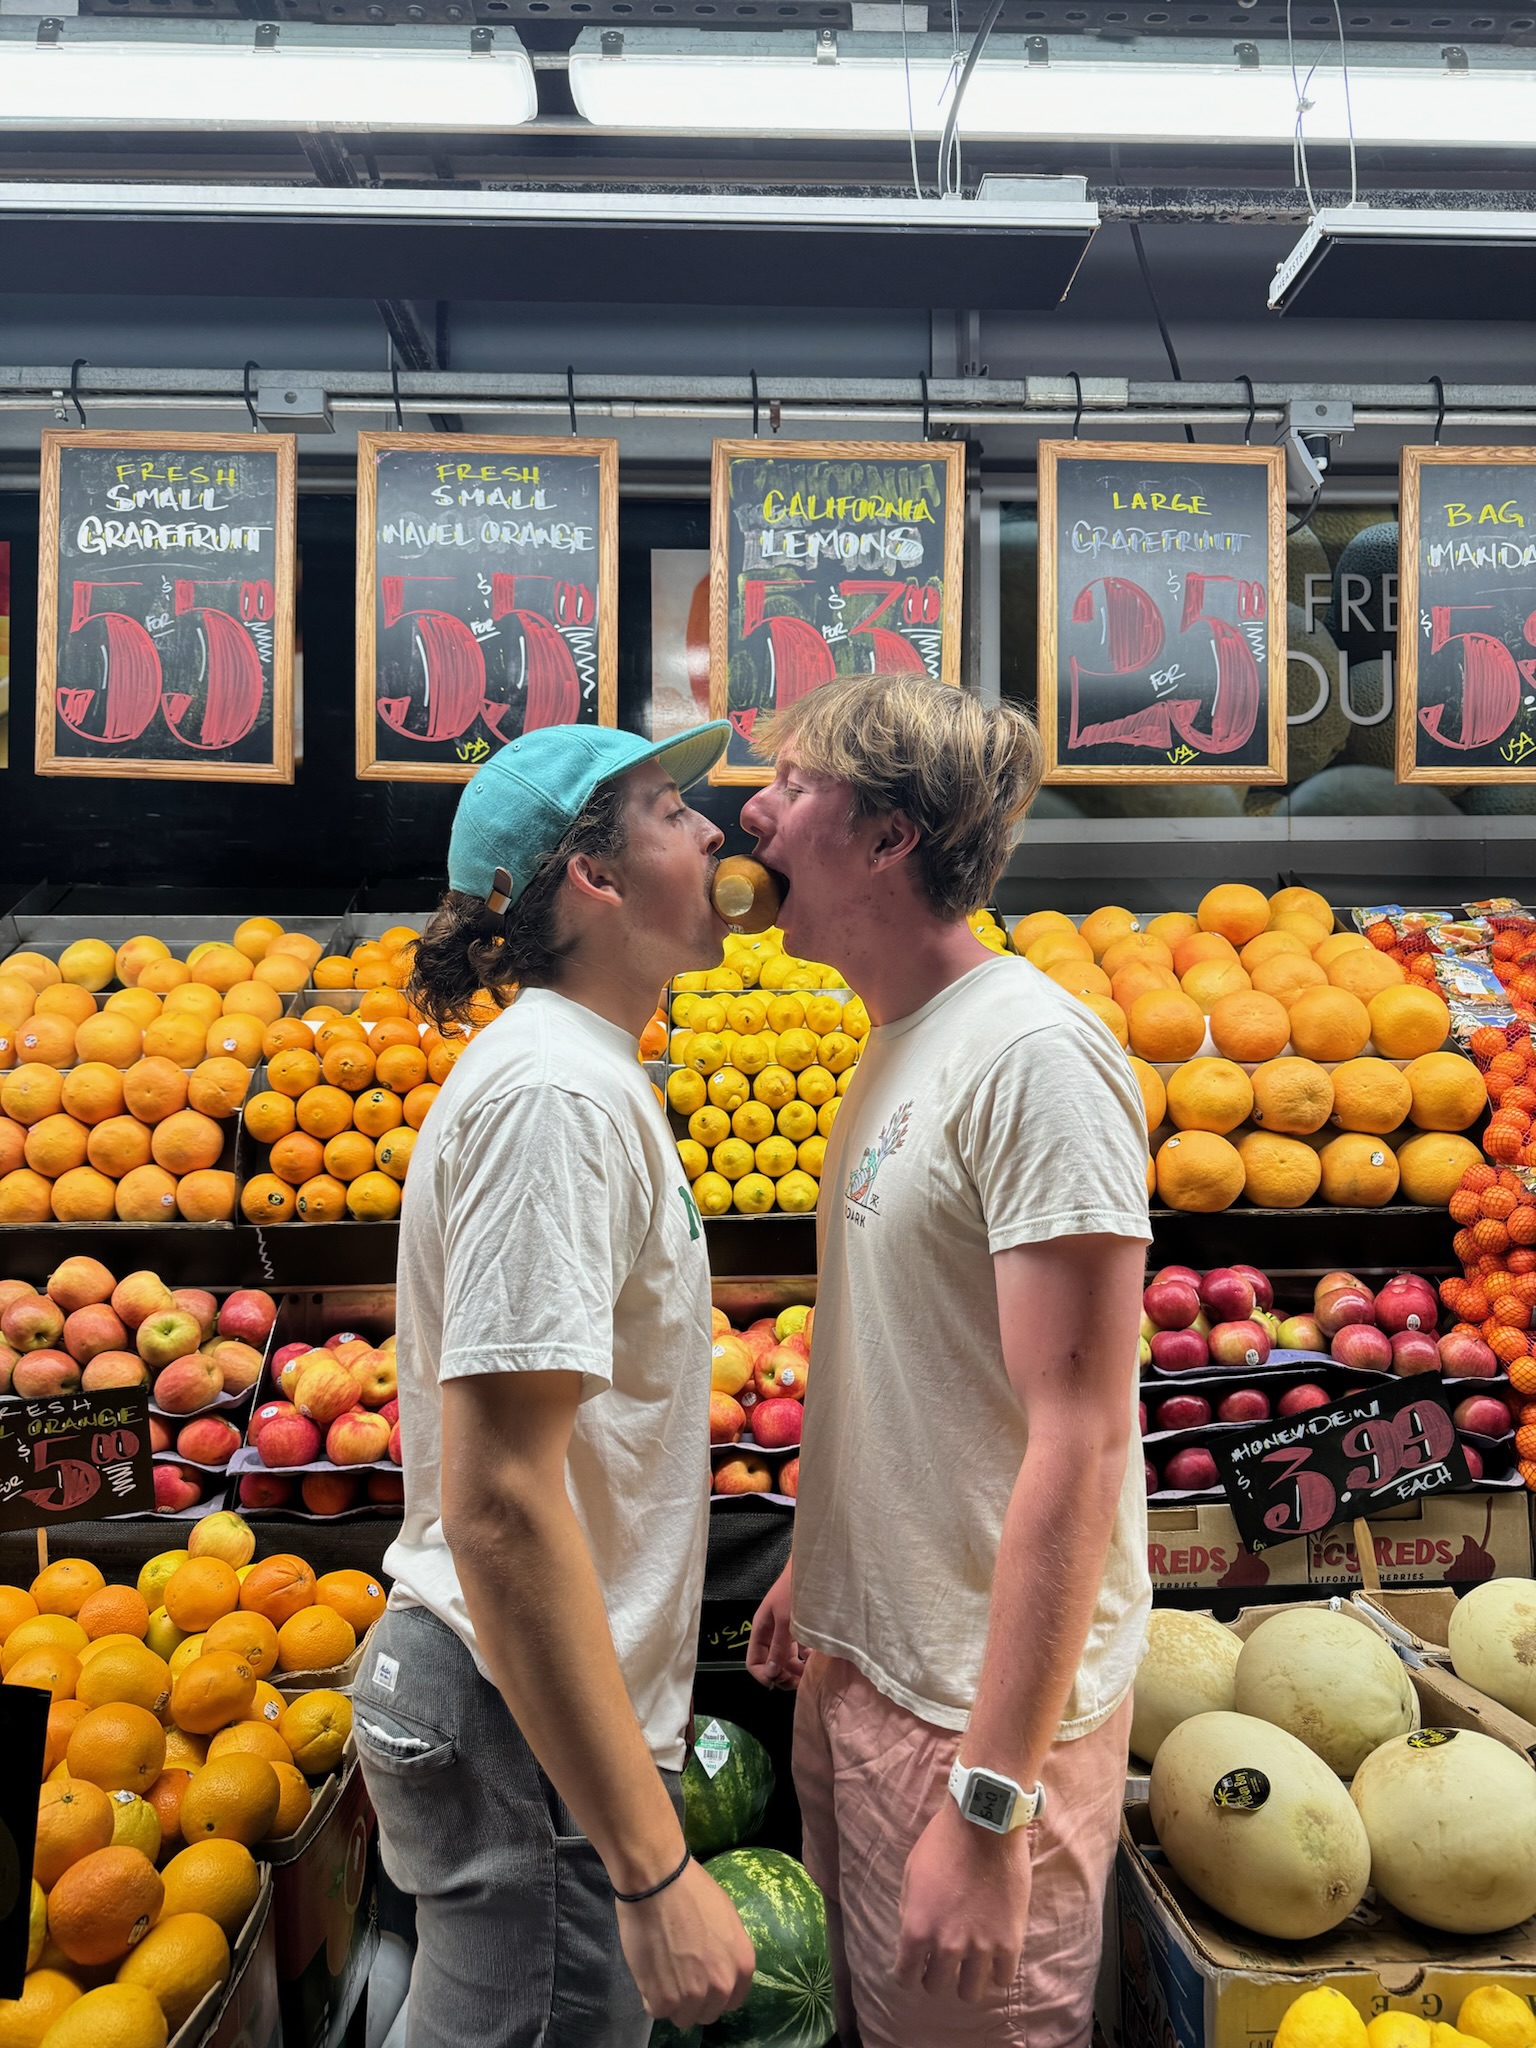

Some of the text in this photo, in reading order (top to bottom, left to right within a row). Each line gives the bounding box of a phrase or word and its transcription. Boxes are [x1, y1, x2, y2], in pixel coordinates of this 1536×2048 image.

[1277, 243, 1310, 292] HEATSTRIP
[116, 463, 238, 487] FRESH
[436, 463, 540, 484] FRESH
[106, 484, 229, 512] SMALL
[430, 485, 558, 510] SMALL
[762, 490, 936, 524] CALIFORNIA
[1112, 492, 1212, 516] LARGE
[1443, 500, 1525, 528] BAG
[77, 515, 274, 556] GRAPEFRUIT
[382, 519, 596, 554] NAVEL ORANGE
[760, 526, 925, 561] LEMONS
[1071, 520, 1252, 559] GRAPEFRUIT
[145, 613, 175, 633] FOR
[470, 617, 496, 636] FOR
[822, 623, 848, 640] FOR
[1148, 662, 1187, 692] FOR
[456, 736, 491, 762] USA
[1166, 743, 1201, 765] USA
[1499, 731, 1536, 763] USA
[27, 1405, 144, 1437] ORANGE
[1231, 1400, 1381, 1463] HONEYDEW
[1396, 1465, 1454, 1500] EACH
[1152, 1581, 1198, 1589] HERRIES
[1309, 1572, 1425, 1584] LIFORNI HERRIES
[707, 1619, 753, 1646] USA
